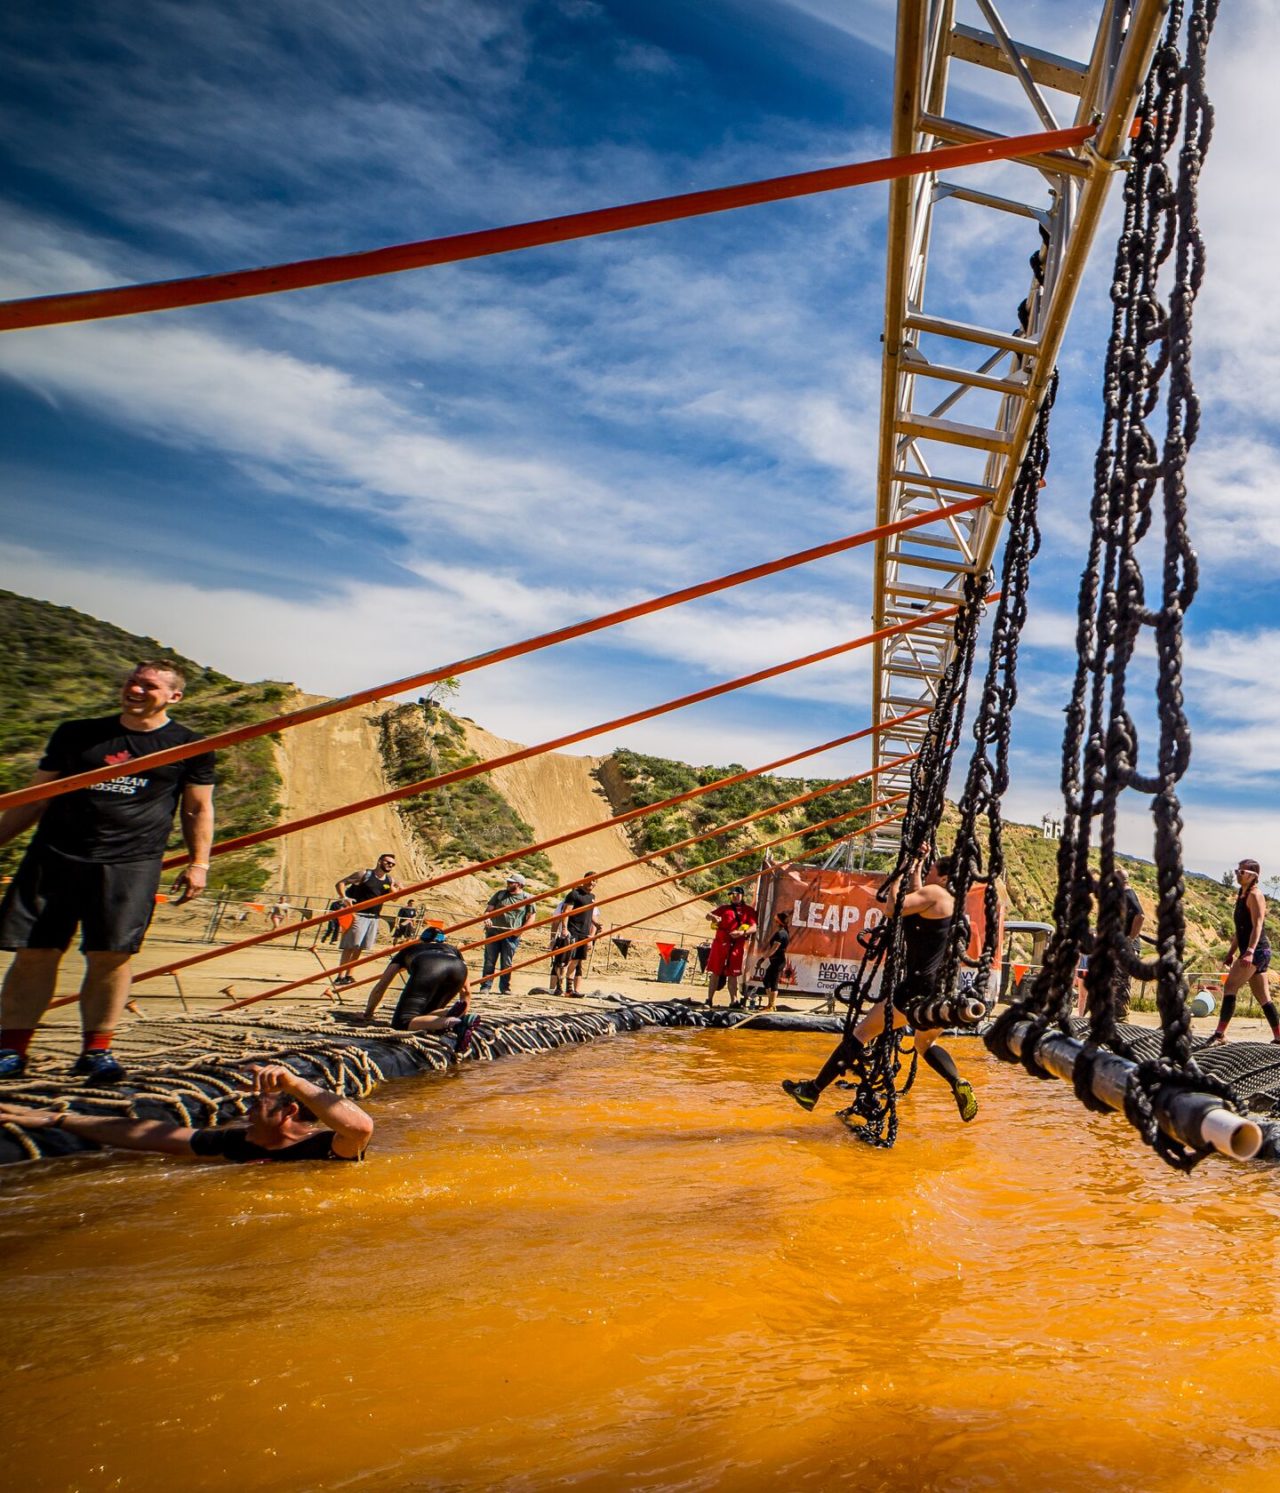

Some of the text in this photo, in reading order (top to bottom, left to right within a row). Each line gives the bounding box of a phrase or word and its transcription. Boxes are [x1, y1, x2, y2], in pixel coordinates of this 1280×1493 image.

[792, 900, 860, 932] LEAP
[819, 962, 848, 973] NAVY
[818, 970, 858, 981] FEDERA
[816, 981, 839, 990] Credi
